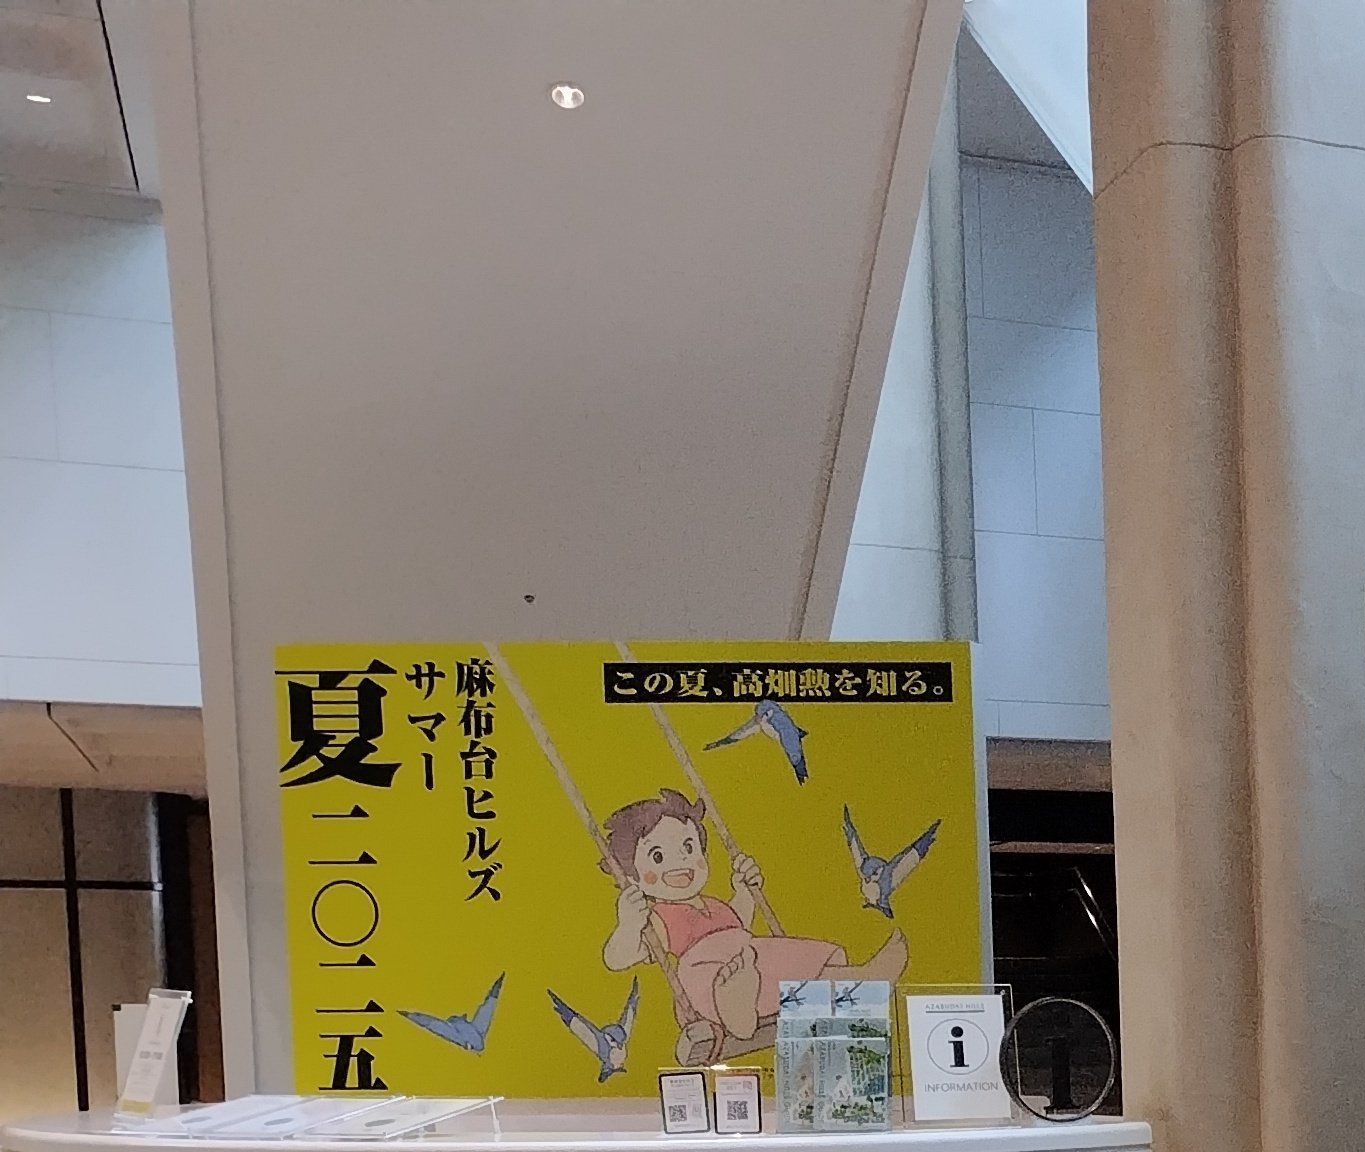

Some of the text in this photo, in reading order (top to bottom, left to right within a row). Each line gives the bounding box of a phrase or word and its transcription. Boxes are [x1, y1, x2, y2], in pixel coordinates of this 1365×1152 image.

[613, 668, 944, 698] この夏、高畑勲を知る。
[404, 660, 447, 791] サマー
[455, 657, 503, 902] 麻布台ヒルズ
[924, 1081, 999, 1093] INFORMATION
